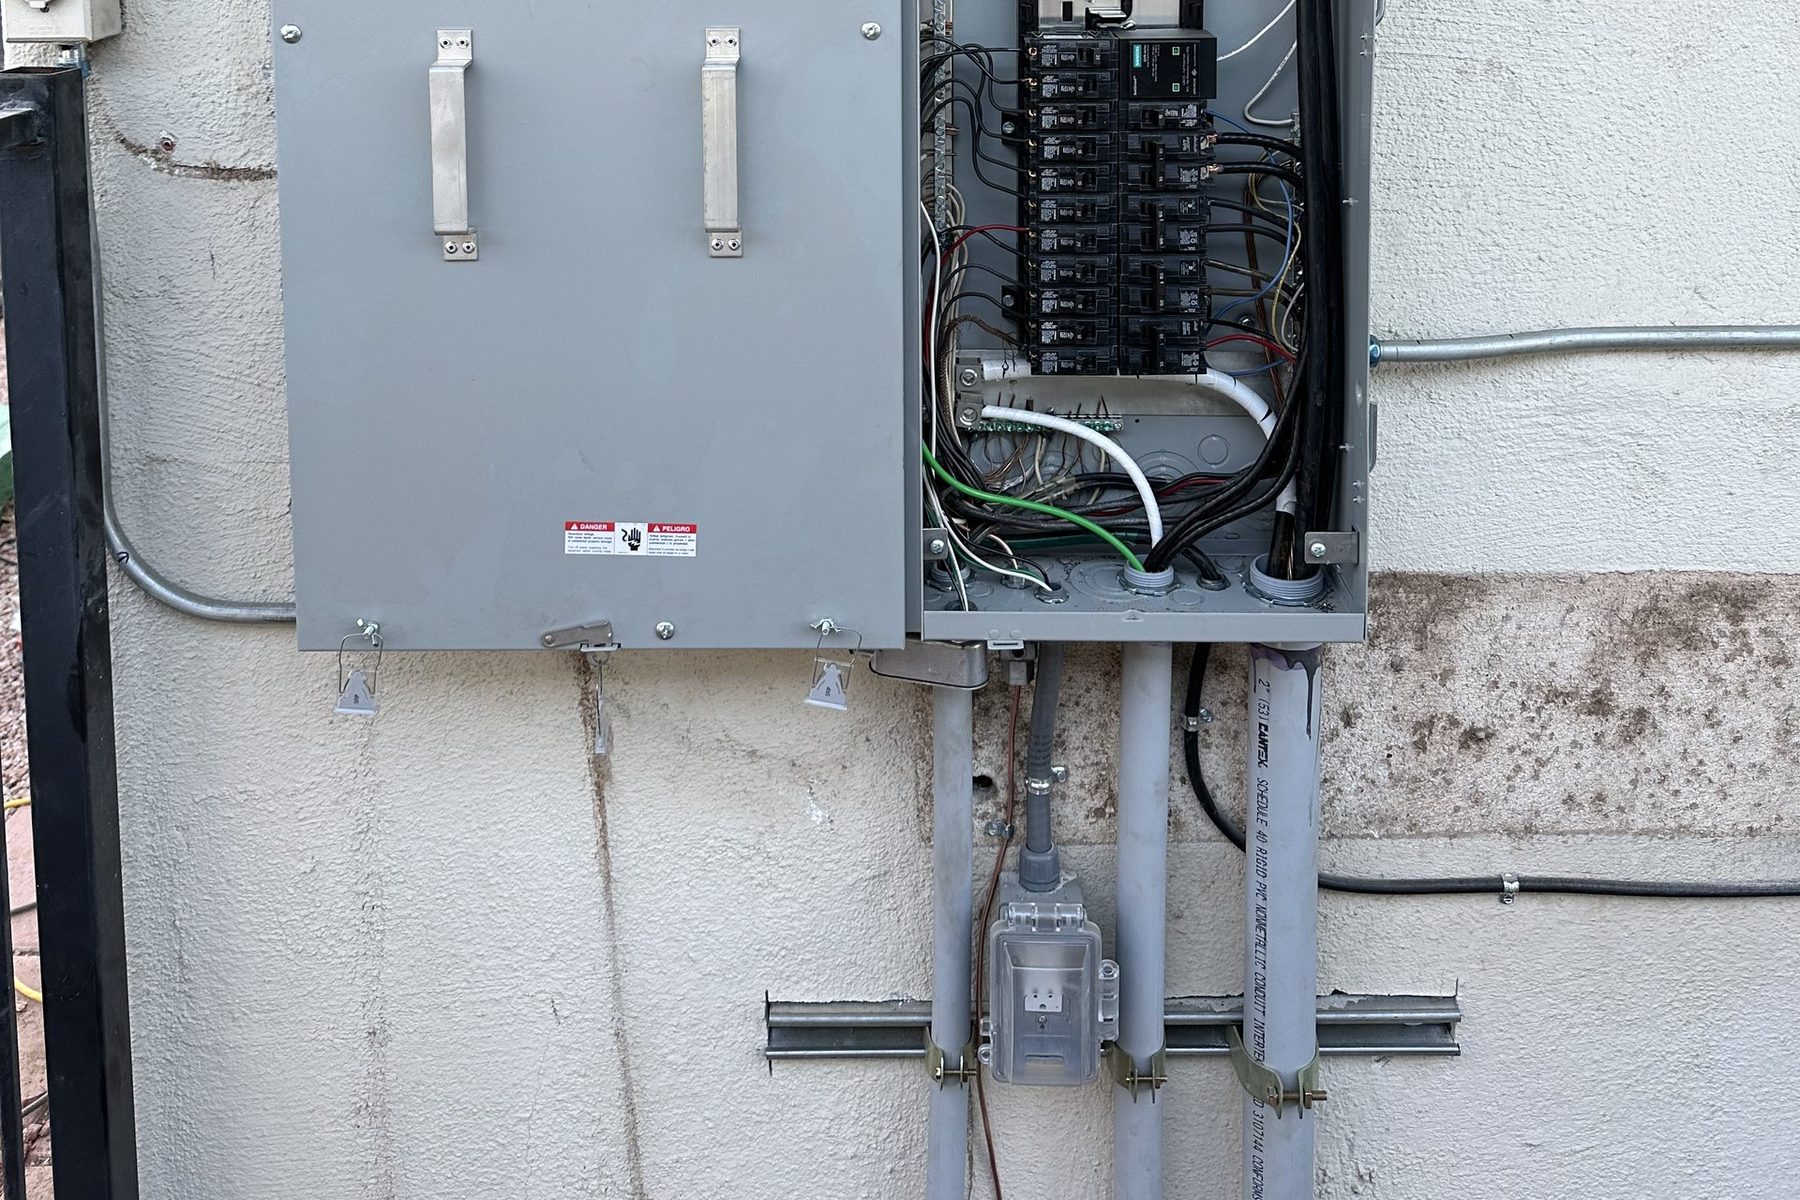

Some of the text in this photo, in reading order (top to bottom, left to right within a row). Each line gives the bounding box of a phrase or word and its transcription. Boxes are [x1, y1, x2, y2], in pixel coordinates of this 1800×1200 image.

[1258, 678, 1271, 693] 2"
[1257, 698, 1270, 720] (53)
[1257, 721, 1269, 768] CANTEX
[1256, 777, 1269, 827] SCHEDULE
[1256, 830, 1268, 842] 40
[1255, 846, 1269, 877] RIGID
[1255, 881, 1268, 901] PVC
[1254, 904, 1268, 970] NONMETALLIC
[1254, 971, 1267, 1017] CONDUIT
[1252, 1110, 1265, 1154] 3107144
[1252, 1155, 1264, 1200] CONFORMS
